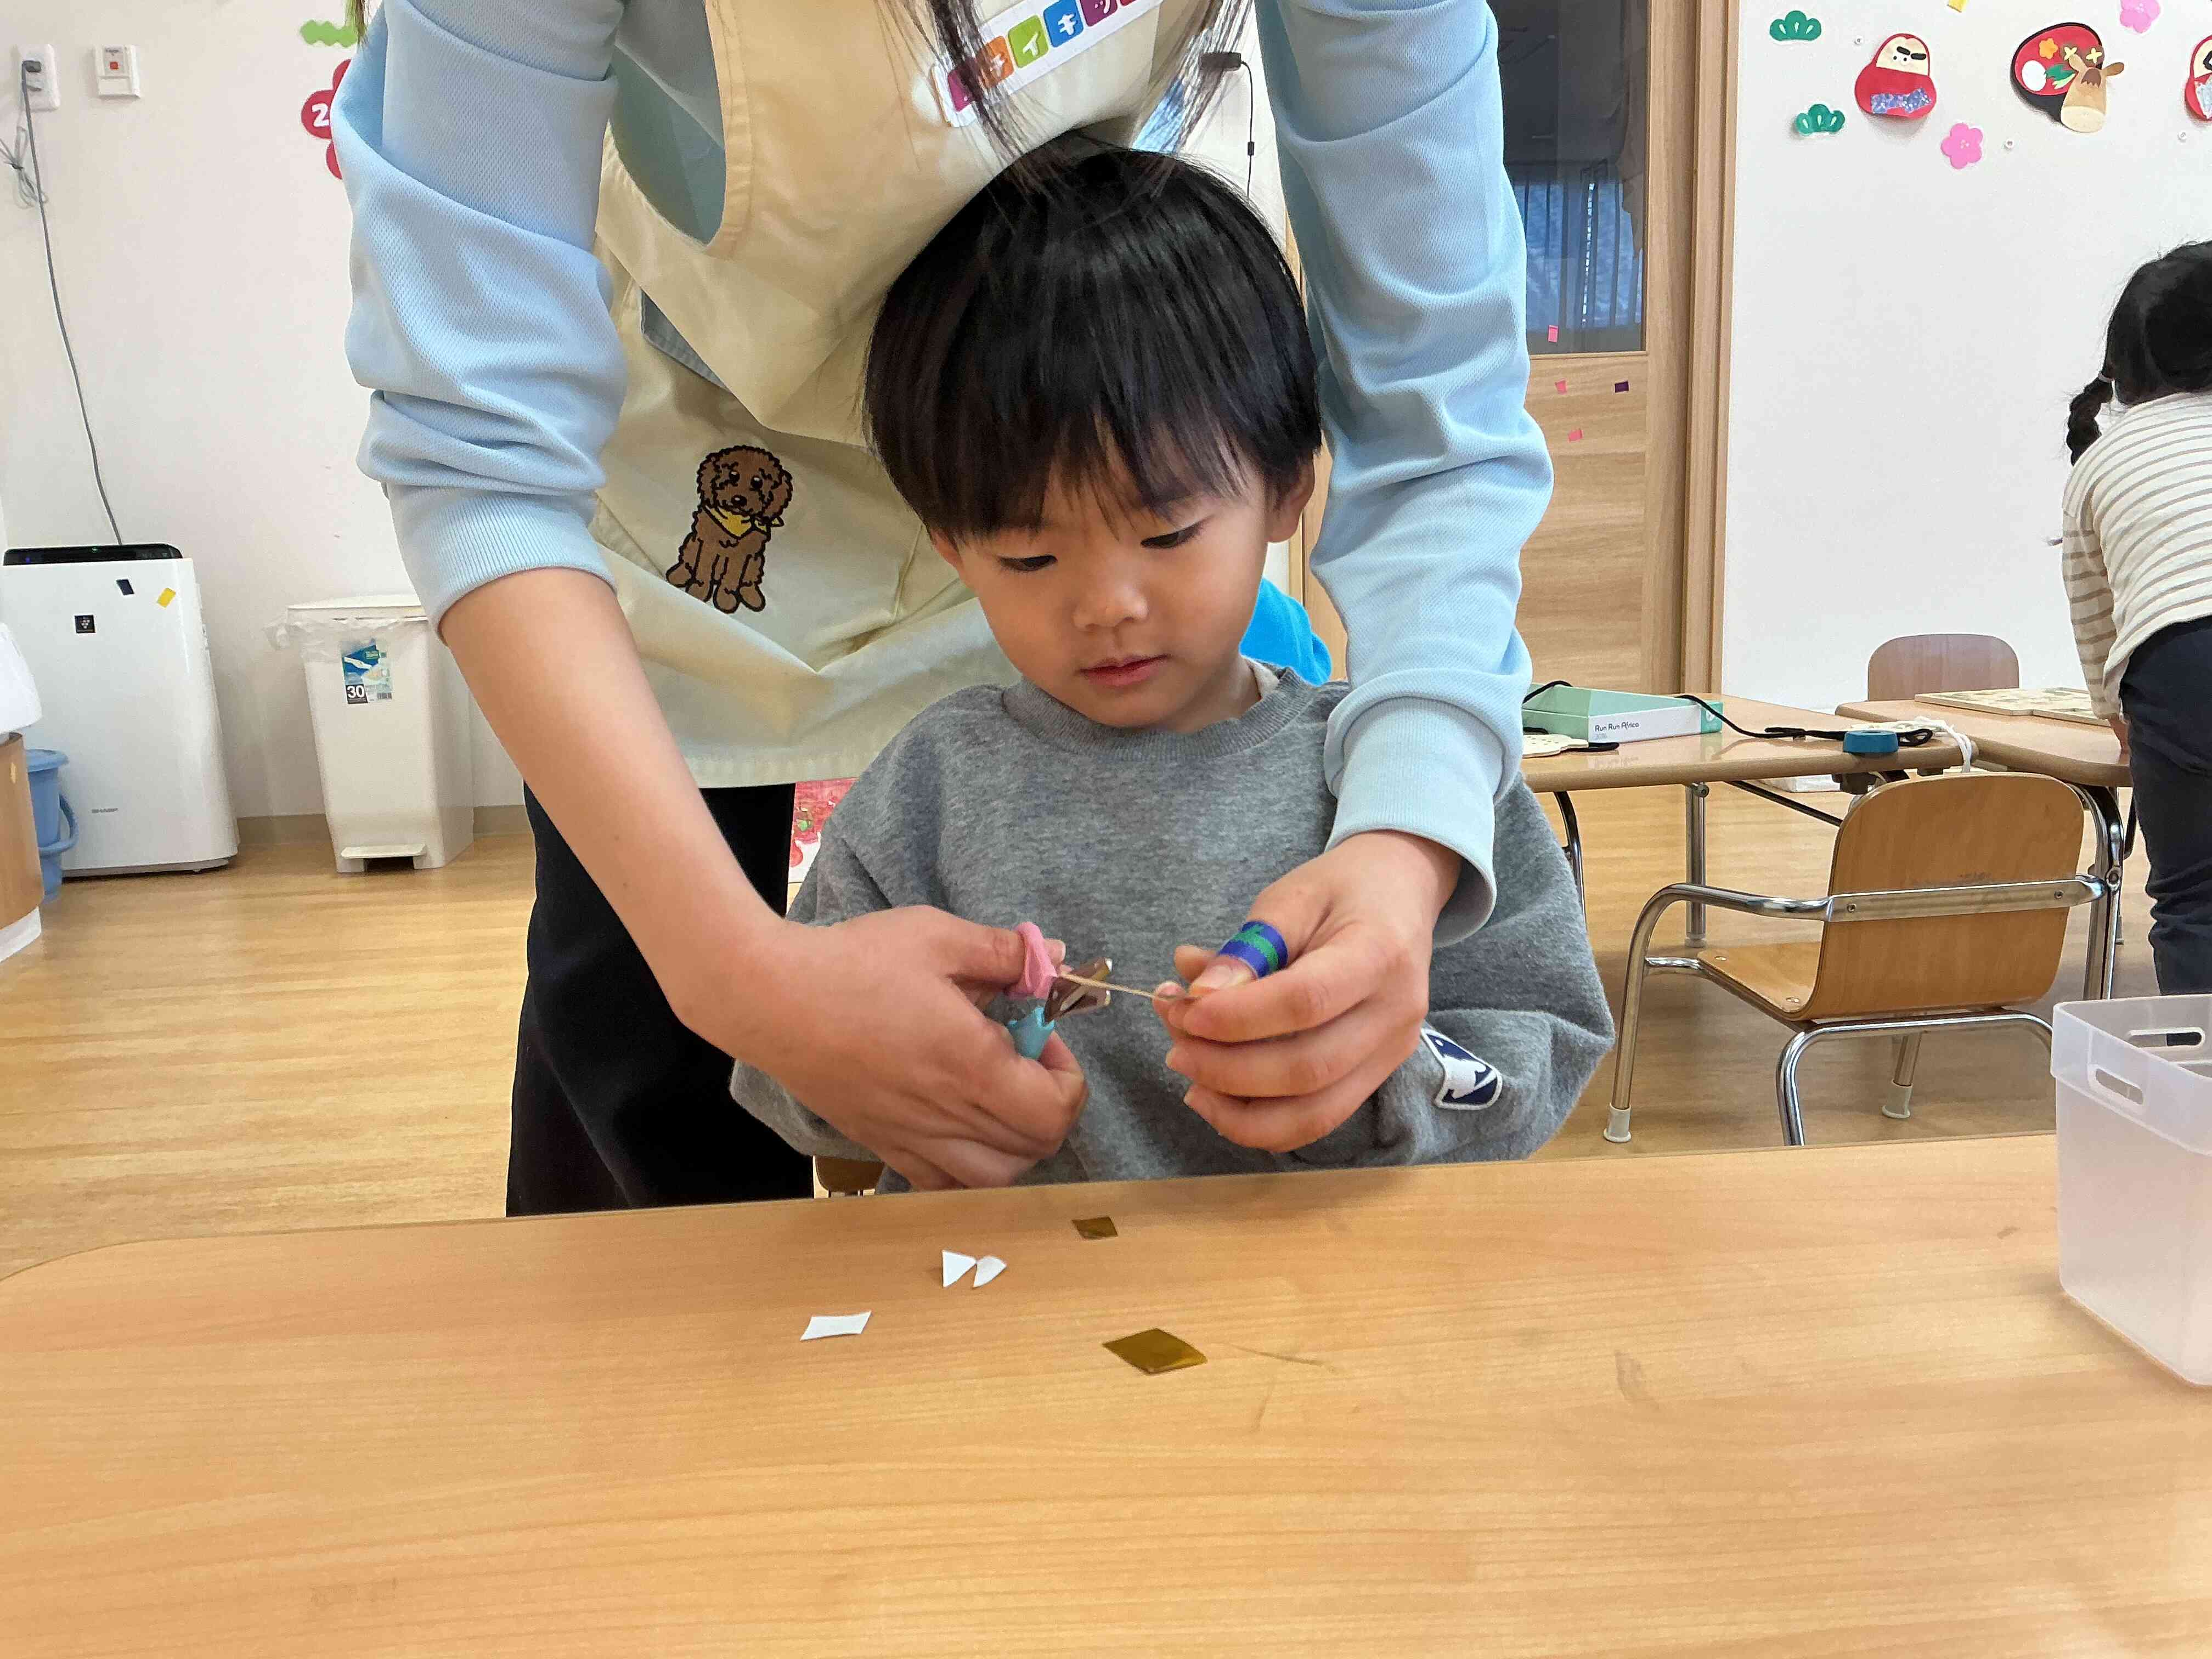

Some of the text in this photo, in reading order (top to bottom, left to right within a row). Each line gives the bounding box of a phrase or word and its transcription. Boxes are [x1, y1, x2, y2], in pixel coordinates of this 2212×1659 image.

[312, 103, 329, 127] 2
[347, 685, 365, 698] 30
[1621, 721, 1639, 730] Africa
